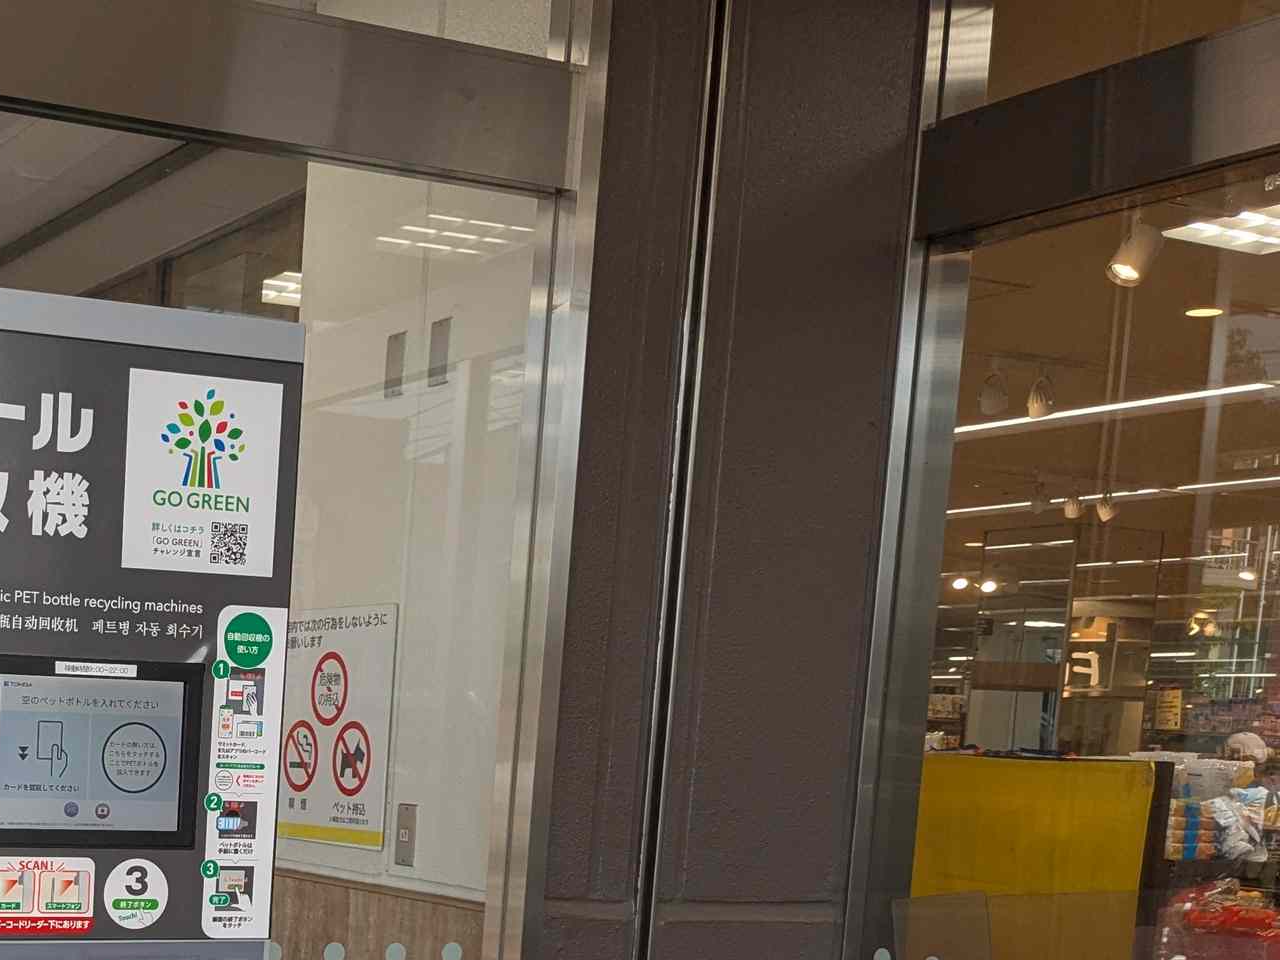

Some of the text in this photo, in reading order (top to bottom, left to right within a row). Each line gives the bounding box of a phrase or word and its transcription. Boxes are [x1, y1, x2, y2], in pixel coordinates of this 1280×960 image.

[153, 490, 250, 513] GO GREEN
[152, 522, 205, 534] 詳しくはコチラ
[14, 591, 40, 604] PET
[43, 592, 80, 607] bottle
[84, 596, 140, 613] recycling
[144, 600, 203, 614] machines
[92, 618, 204, 640] 페트병 자동 회수기
[218, 664, 224, 675] 1
[21, 695, 159, 710] 空のペットボトルを入れてください
[210, 797, 217, 807] 2
[19, 861, 55, 871] SCAN!
[207, 864, 214, 874] 3
[124, 865, 148, 896] 3
